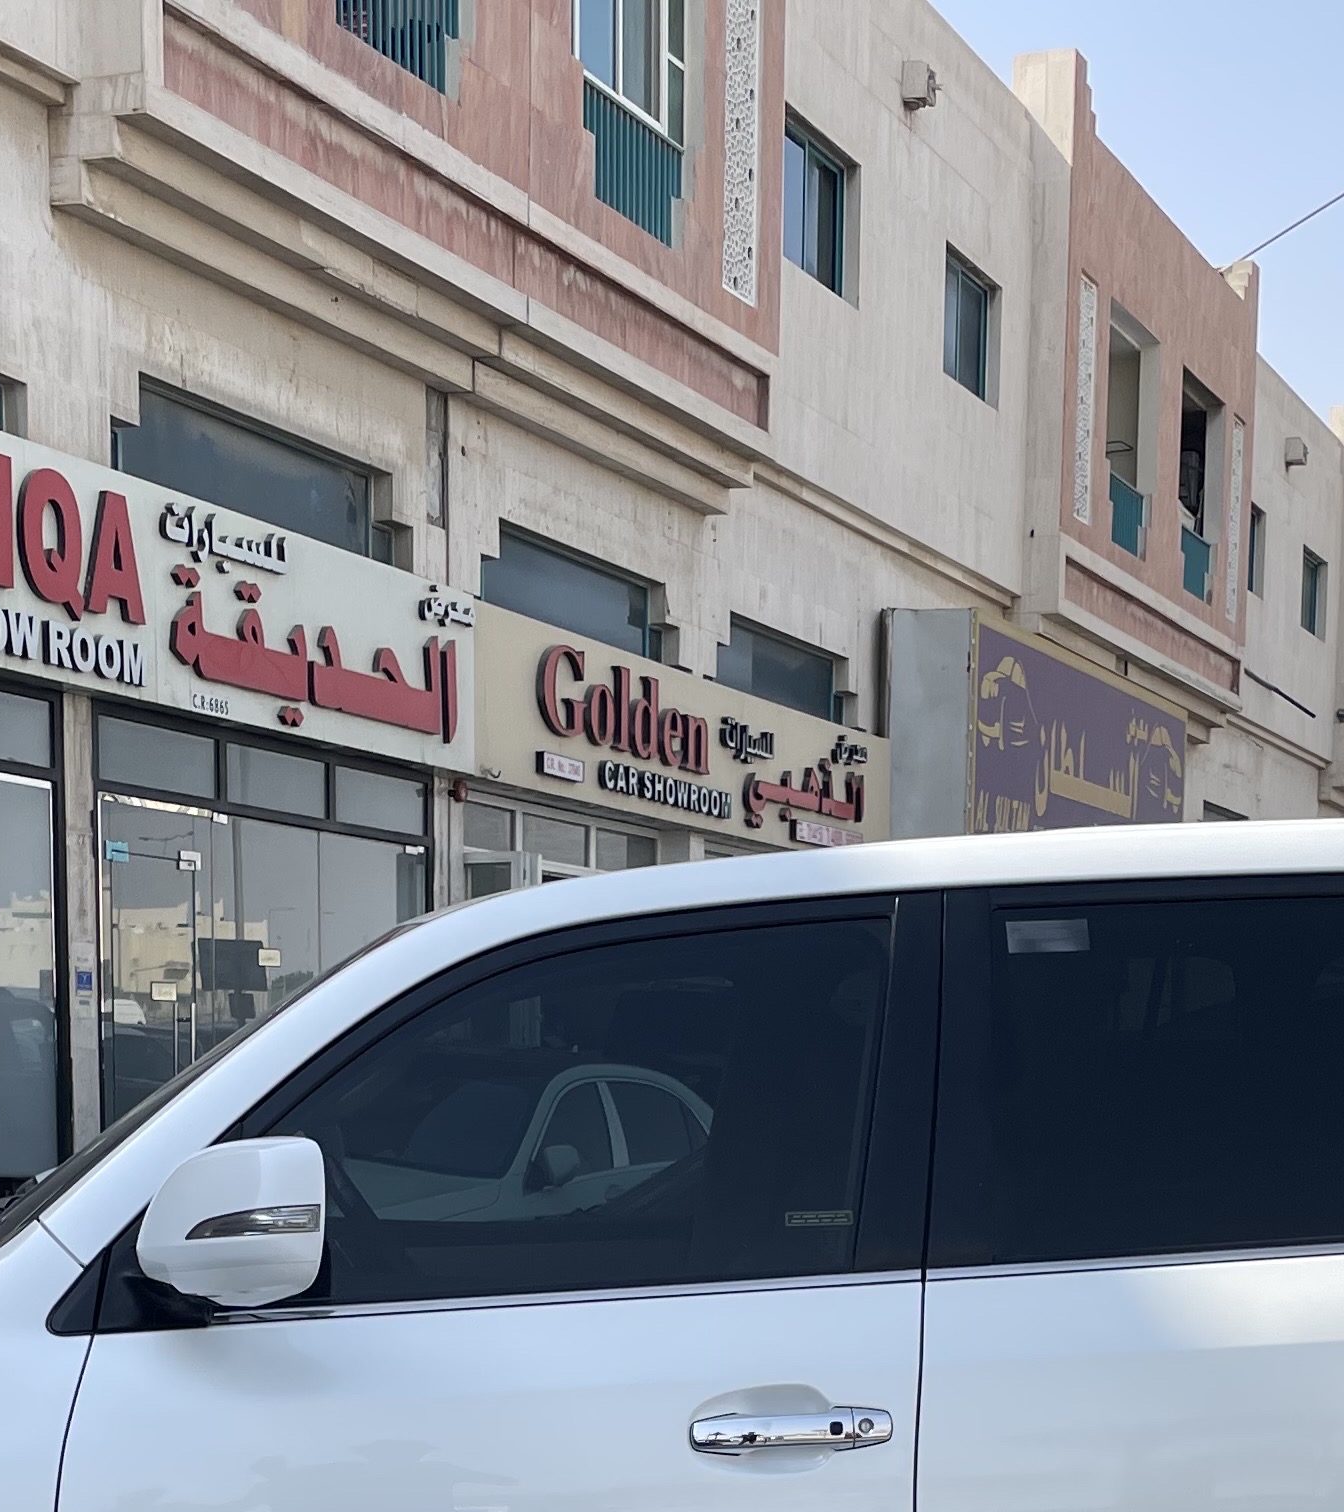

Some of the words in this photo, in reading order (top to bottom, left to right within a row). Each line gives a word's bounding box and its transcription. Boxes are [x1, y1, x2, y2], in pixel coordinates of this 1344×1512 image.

[169, 563, 458, 745] الحديقة
[537, 644, 711, 776] Golden
[598, 759, 639, 798] CAR
[643, 770, 732, 819] SHOWROOM
[742, 757, 865, 829] الذهبي
[1034, 718, 1141, 822] السلطان
